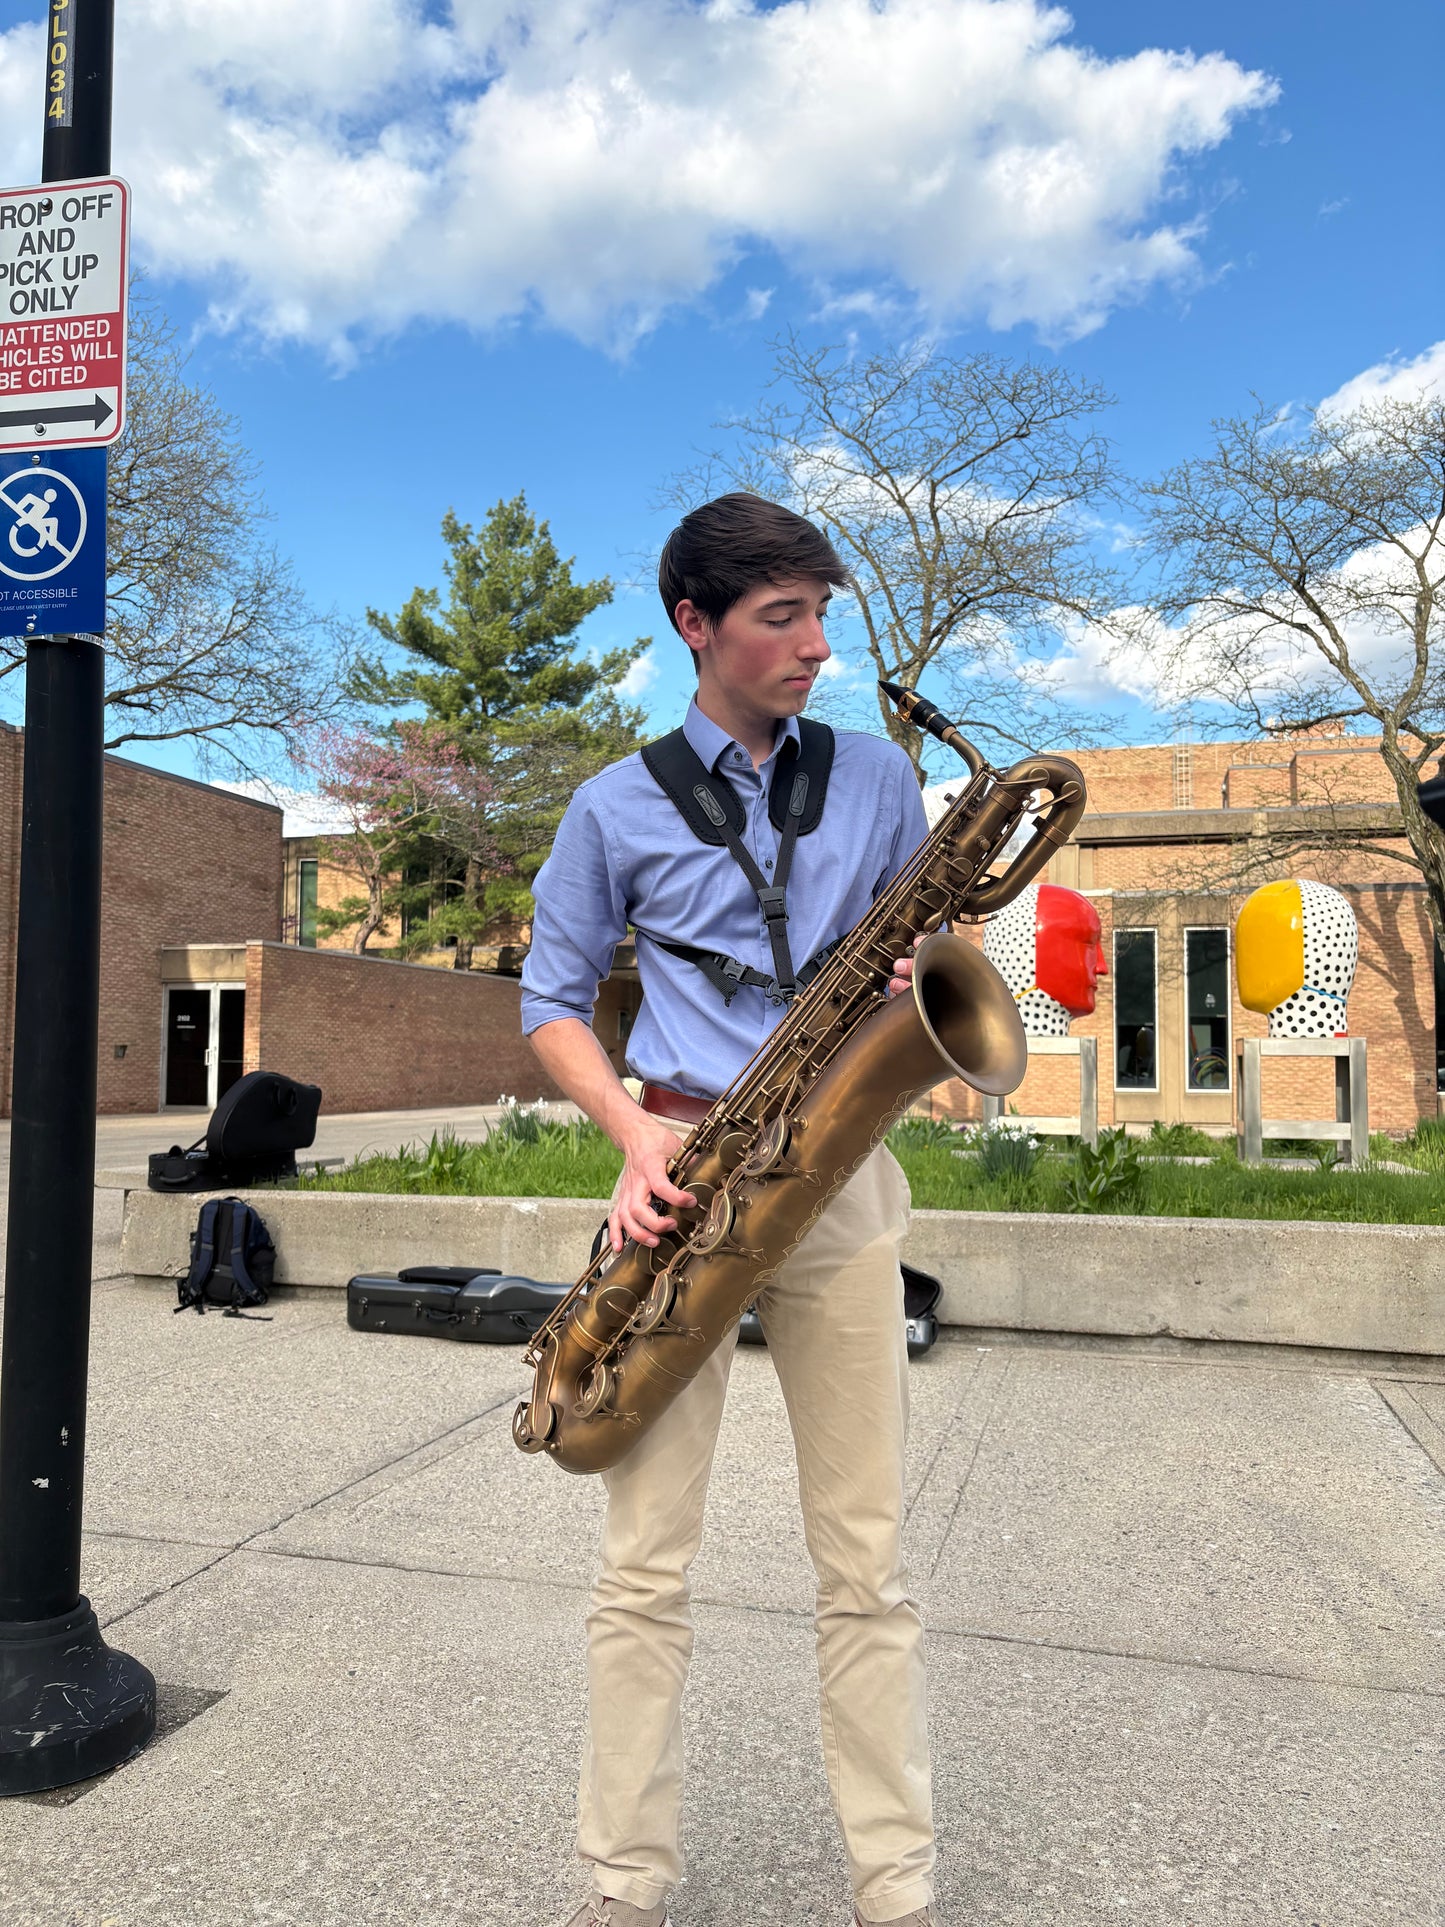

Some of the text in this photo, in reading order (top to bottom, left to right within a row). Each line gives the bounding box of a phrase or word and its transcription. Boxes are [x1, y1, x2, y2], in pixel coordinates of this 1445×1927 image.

[62, 193, 113, 222] OFF
[17, 227, 75, 257] AND
[63, 254, 98, 280] UP
[10, 285, 79, 315] ONLY
[0, 319, 110, 346] ATTENDED
[70, 341, 118, 361] WILL
[0, 365, 87, 390] BE CITED
[12, 588, 78, 600] ACCESSIBLE
